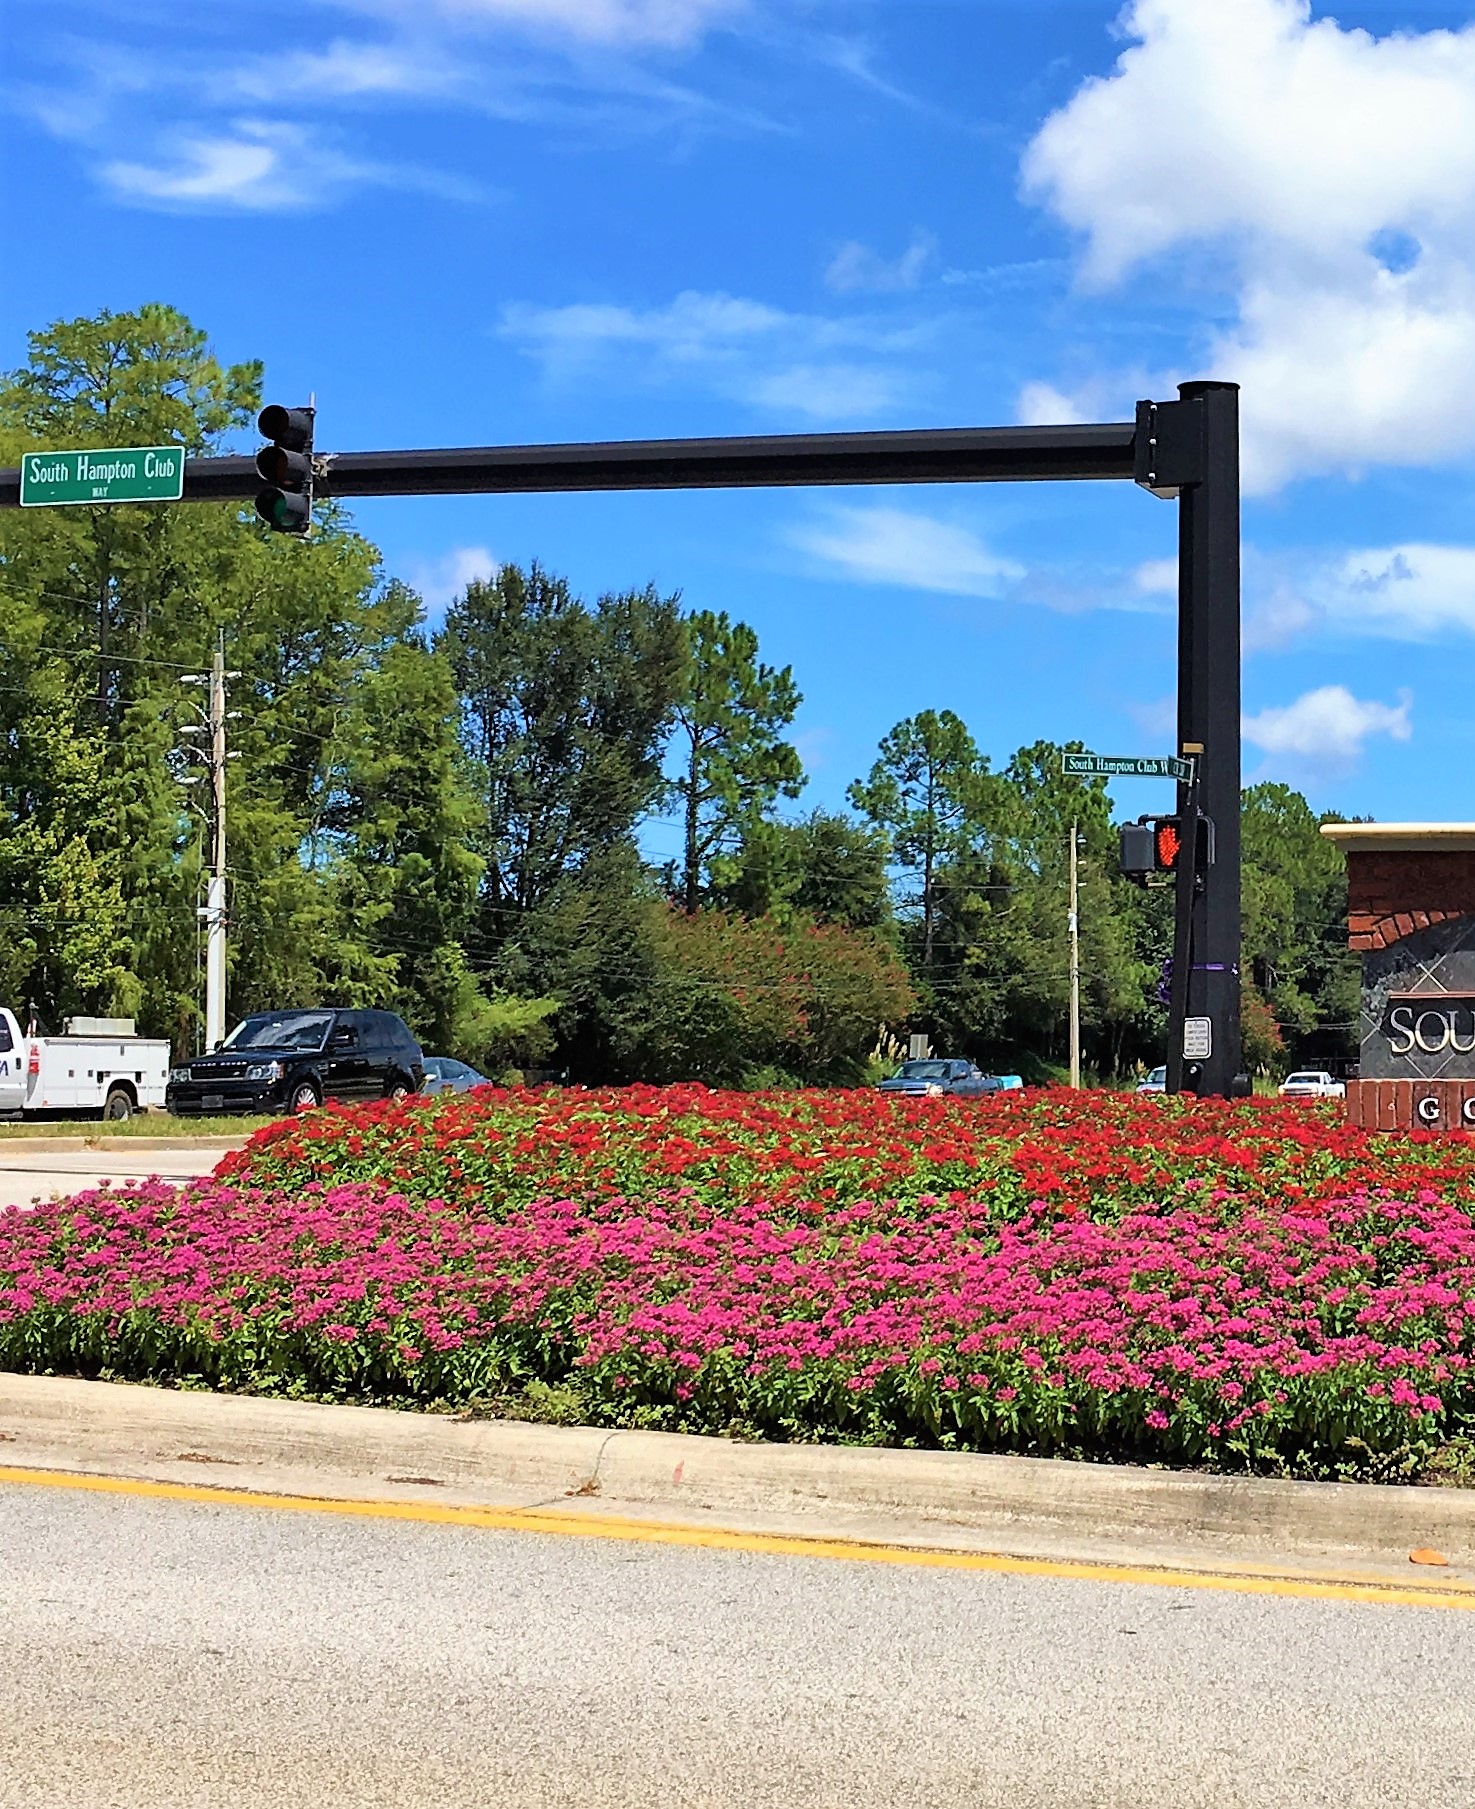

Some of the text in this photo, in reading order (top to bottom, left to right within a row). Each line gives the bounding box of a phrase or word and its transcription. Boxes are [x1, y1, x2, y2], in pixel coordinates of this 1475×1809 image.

[30, 452, 175, 483] South Hampton Club
[92, 487, 109, 497] WAY
[1069, 757, 1094, 770] South
[1096, 758, 1135, 774] Hampton
[1137, 760, 1158, 773] Club
